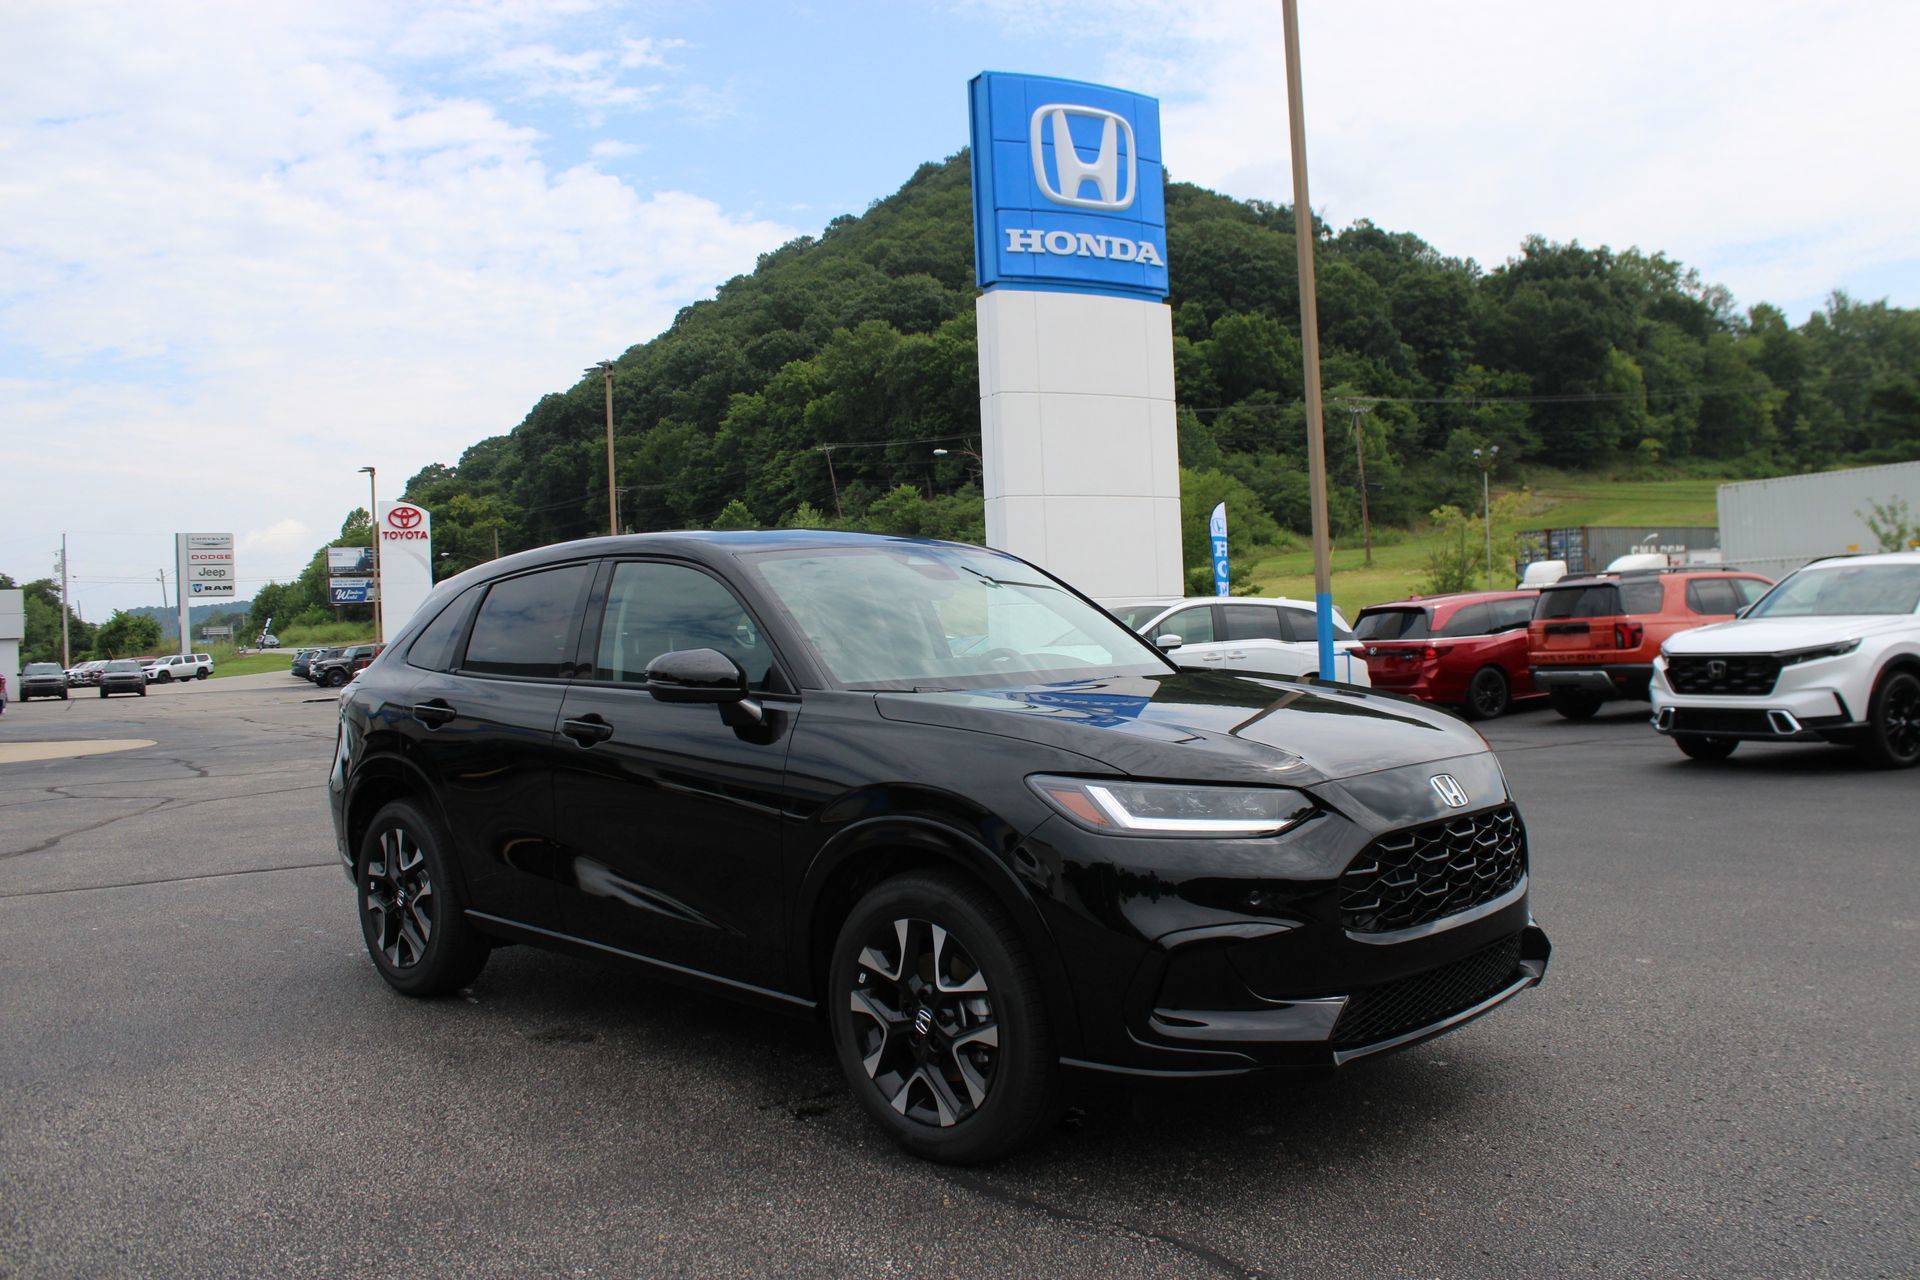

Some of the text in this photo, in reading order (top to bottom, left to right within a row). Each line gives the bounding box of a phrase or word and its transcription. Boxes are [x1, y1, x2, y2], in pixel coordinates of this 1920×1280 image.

[1005, 228, 1164, 267] HONDA
[382, 531, 428, 540] TOYOTA
[198, 567, 226, 578] Jeep
